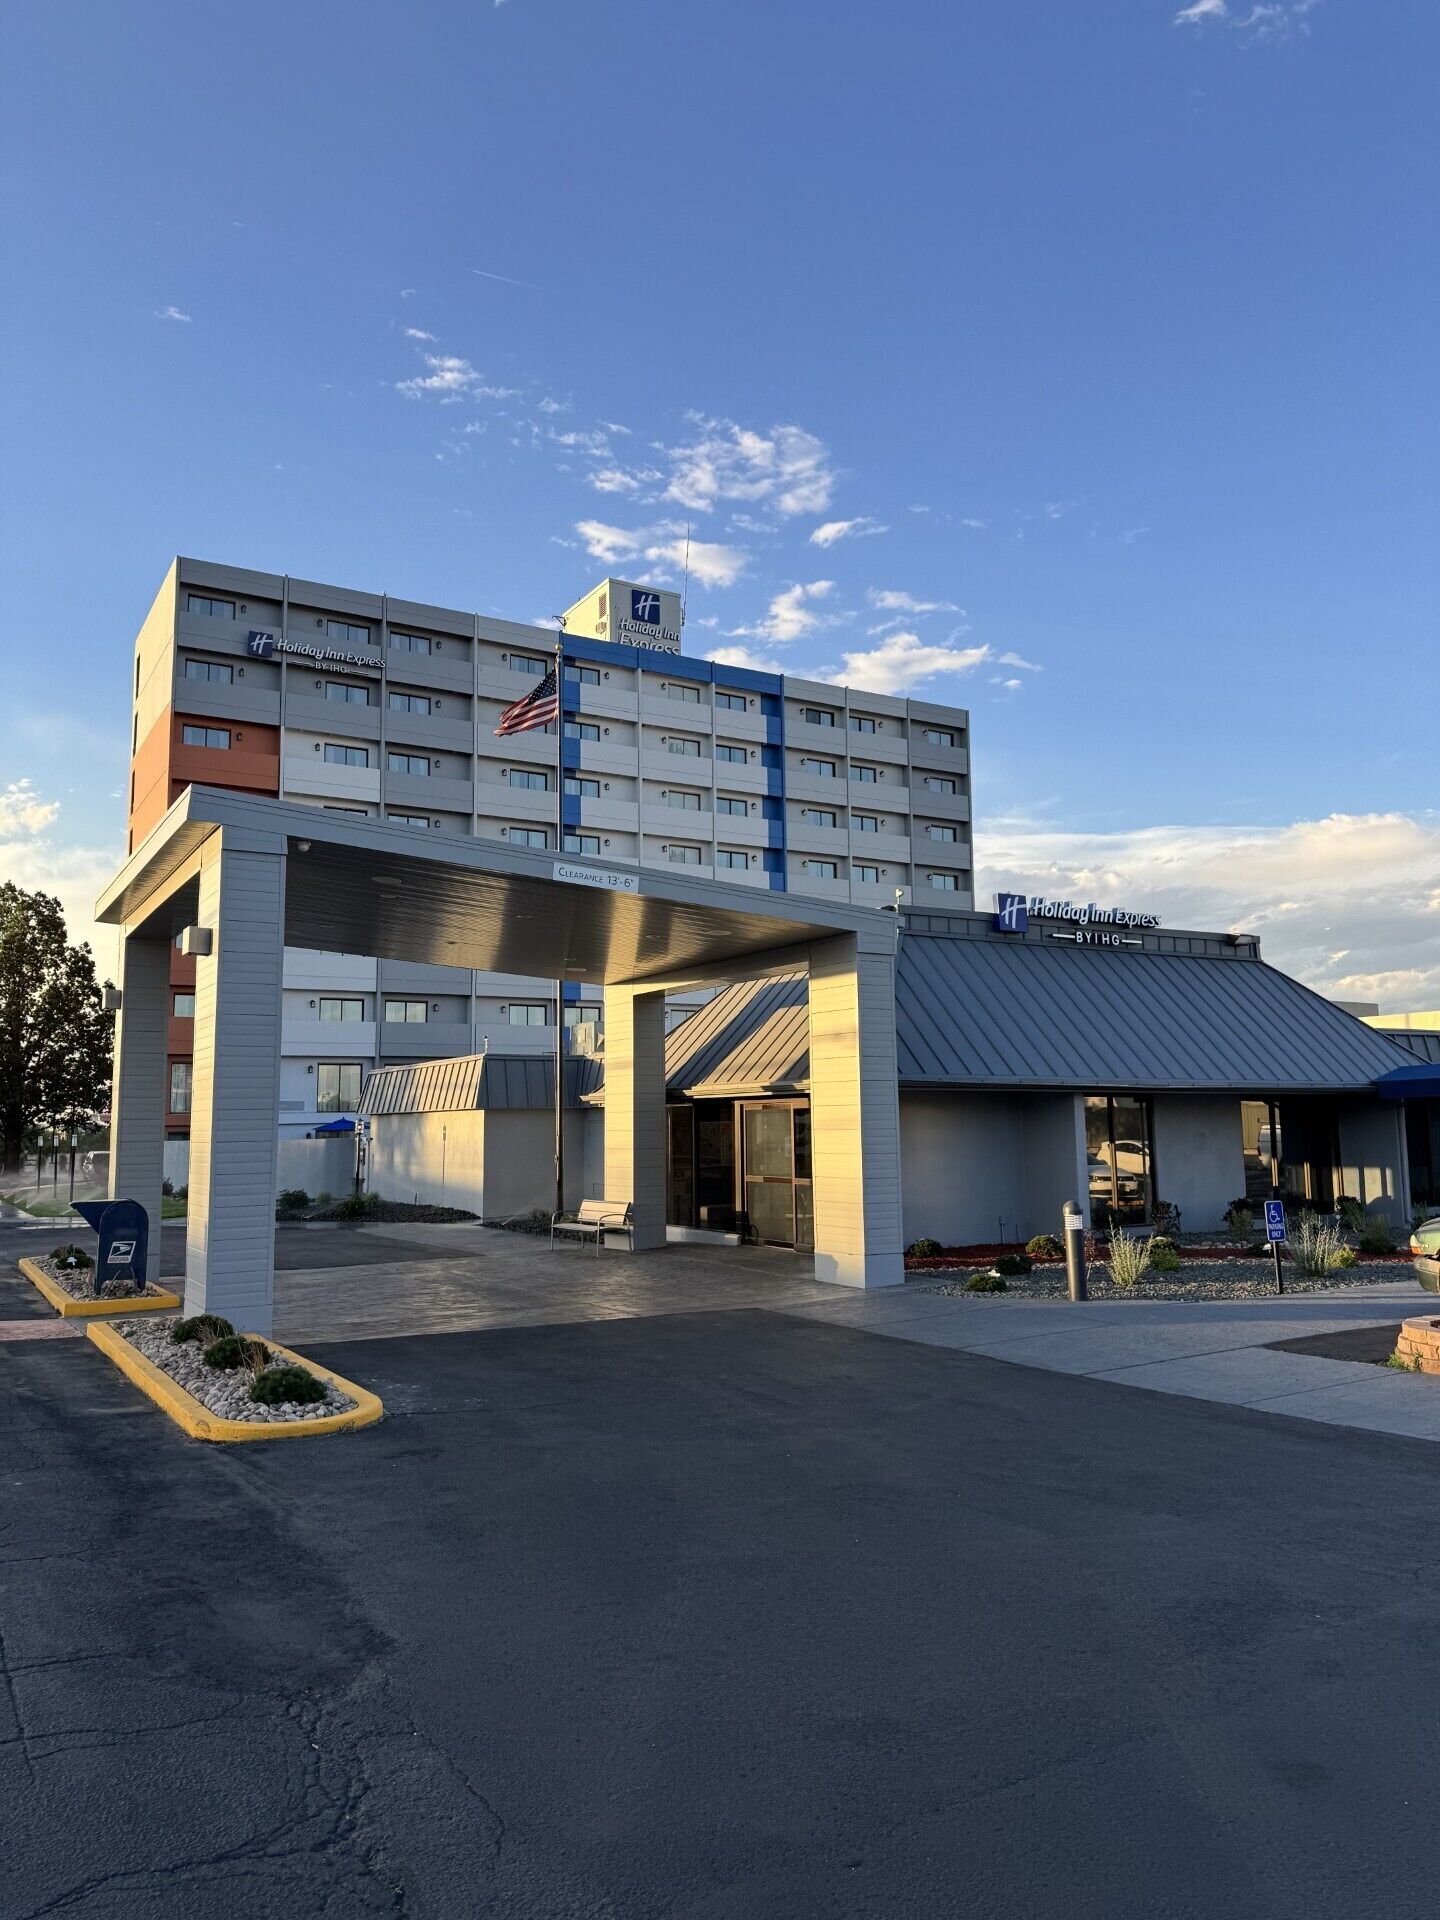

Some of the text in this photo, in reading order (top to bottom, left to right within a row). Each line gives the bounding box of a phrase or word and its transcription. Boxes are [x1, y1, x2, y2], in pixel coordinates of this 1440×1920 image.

[620, 618, 681, 641] Holiday Inn
[277, 638, 324, 659] Holiday
[325, 646, 345, 661] Inn
[346, 651, 386, 668] Express
[315, 661, 329, 671] BY
[1033, 898, 1089, 925] Holiday
[1090, 903, 1114, 924] Inn
[1115, 908, 1163, 929] Express
[1075, 931, 1121, 946] BY IHG
